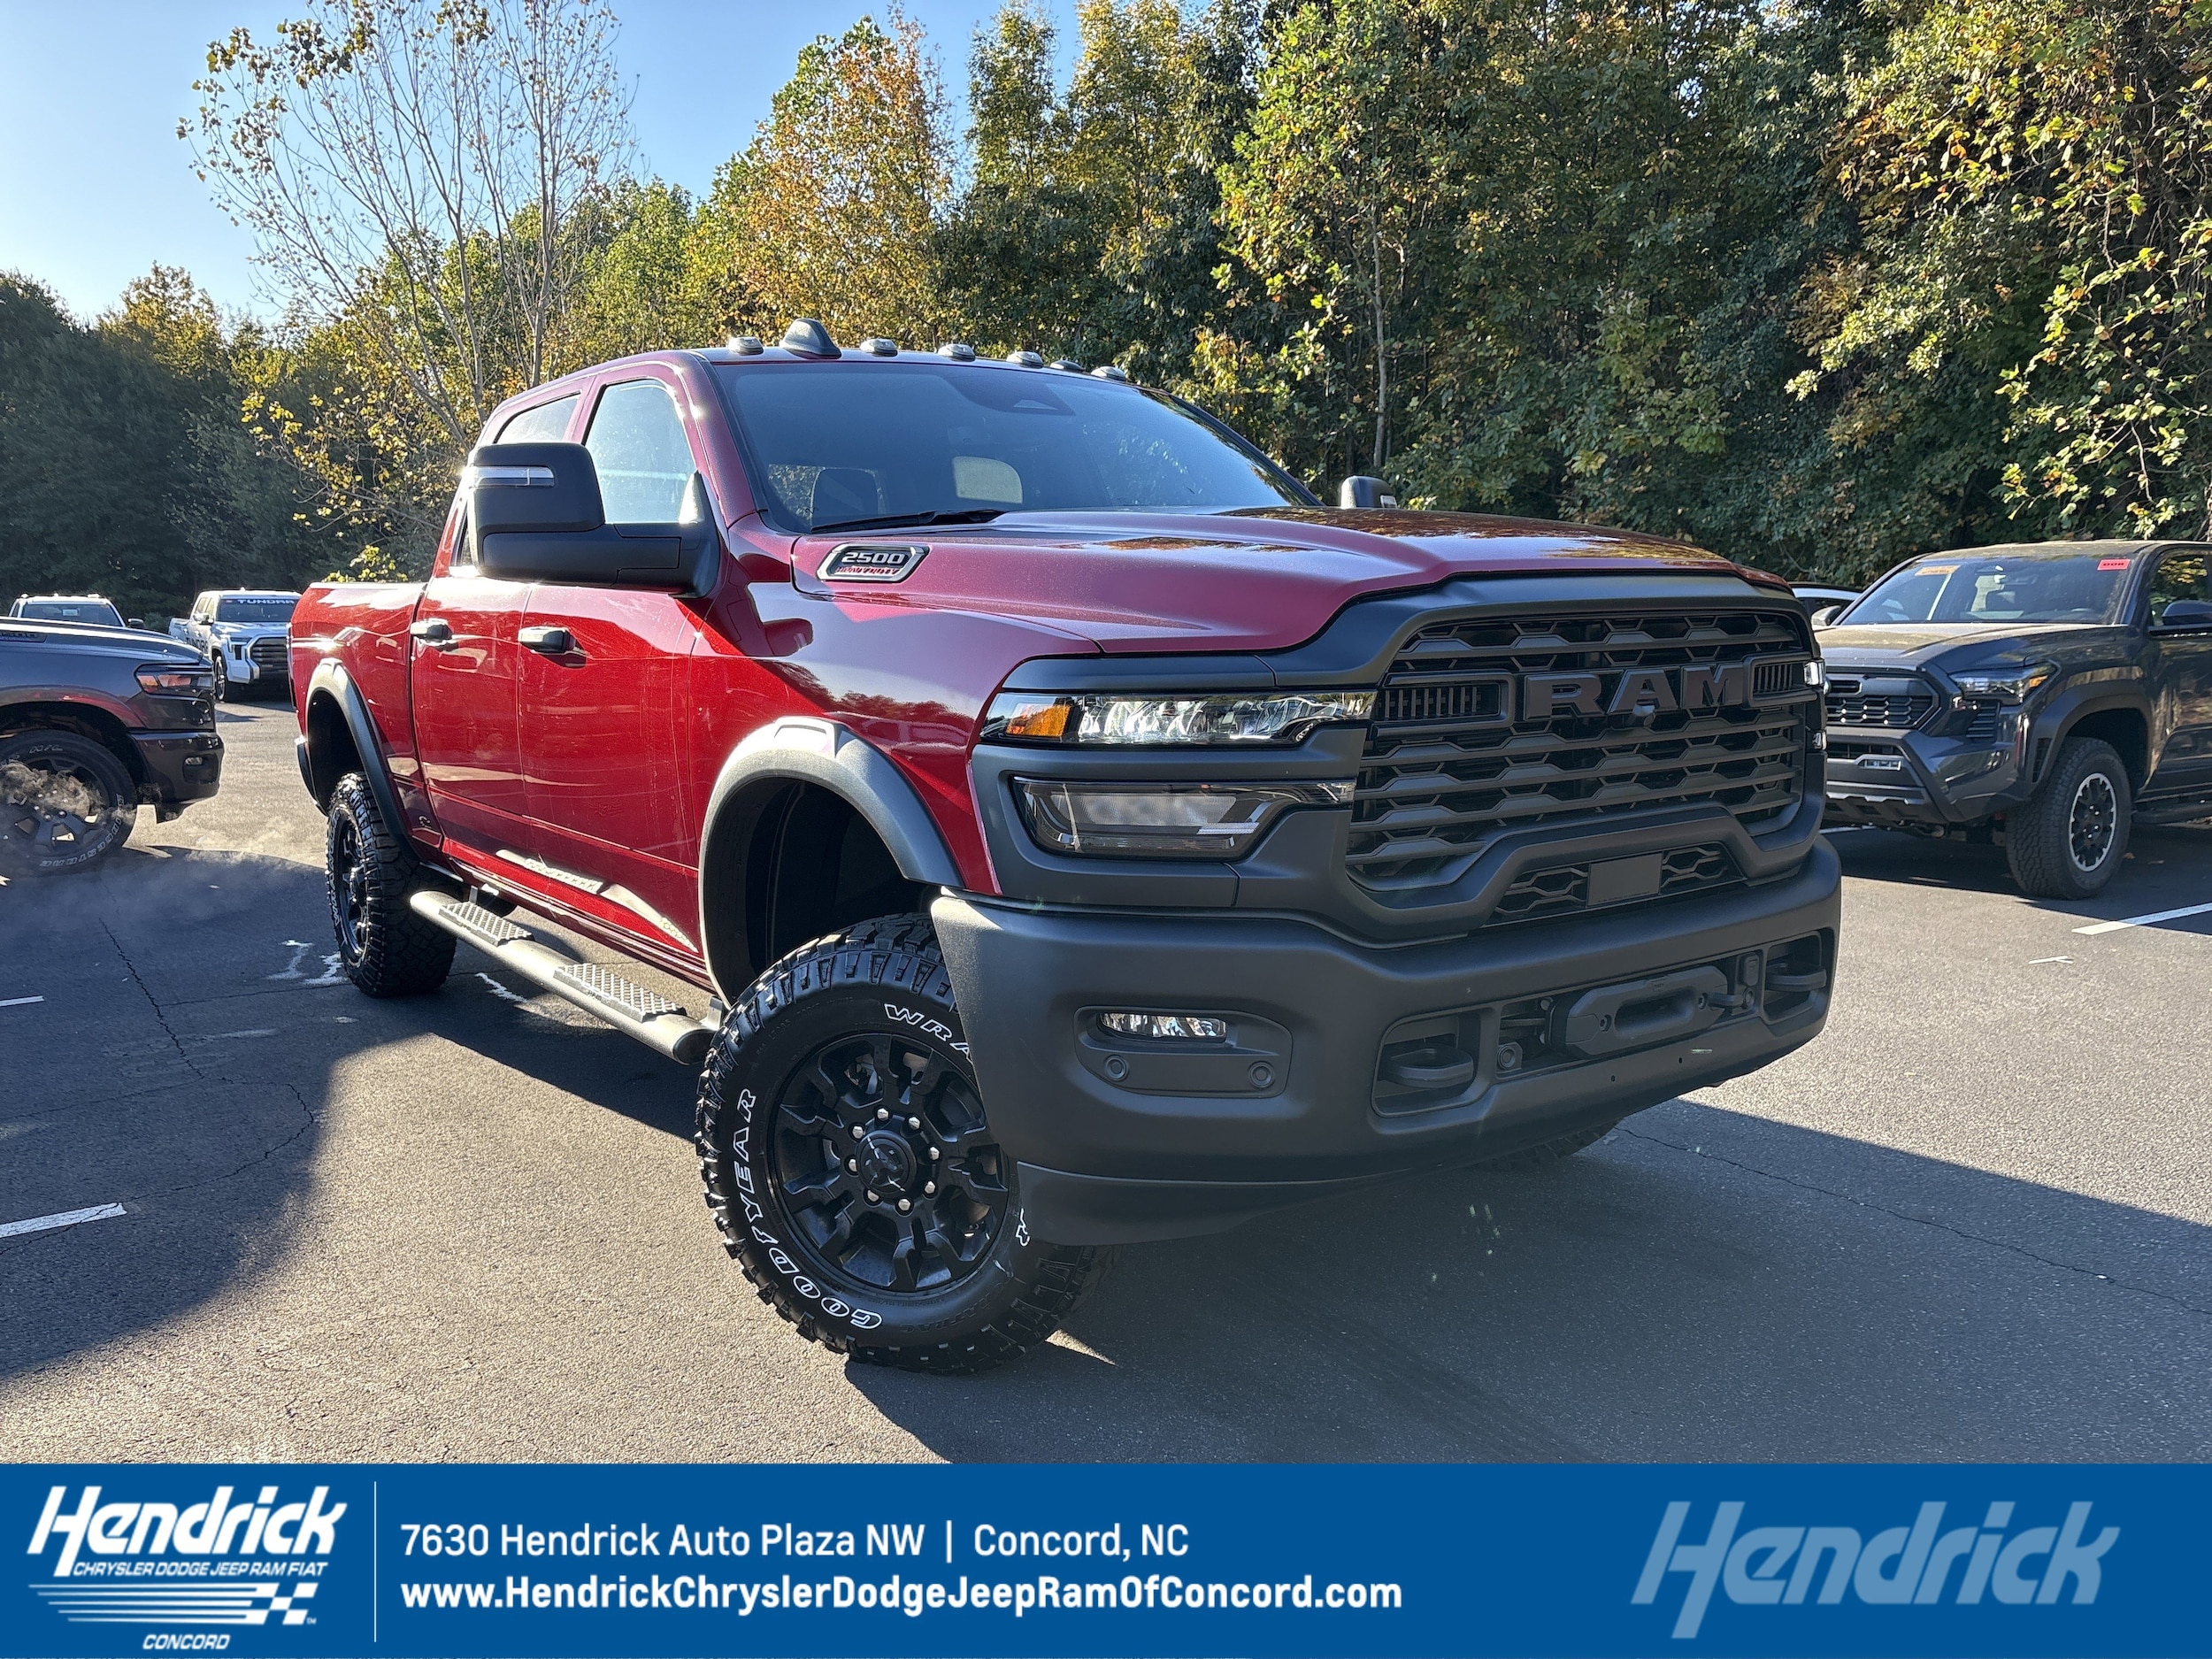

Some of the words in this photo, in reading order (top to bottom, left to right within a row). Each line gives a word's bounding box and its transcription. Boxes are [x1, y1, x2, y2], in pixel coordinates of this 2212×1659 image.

[841, 551, 905, 565] 2500
[1524, 664, 1745, 721] RAM
[884, 1002, 974, 1066] WRA
[733, 1087, 883, 1330] GOODYEAR
